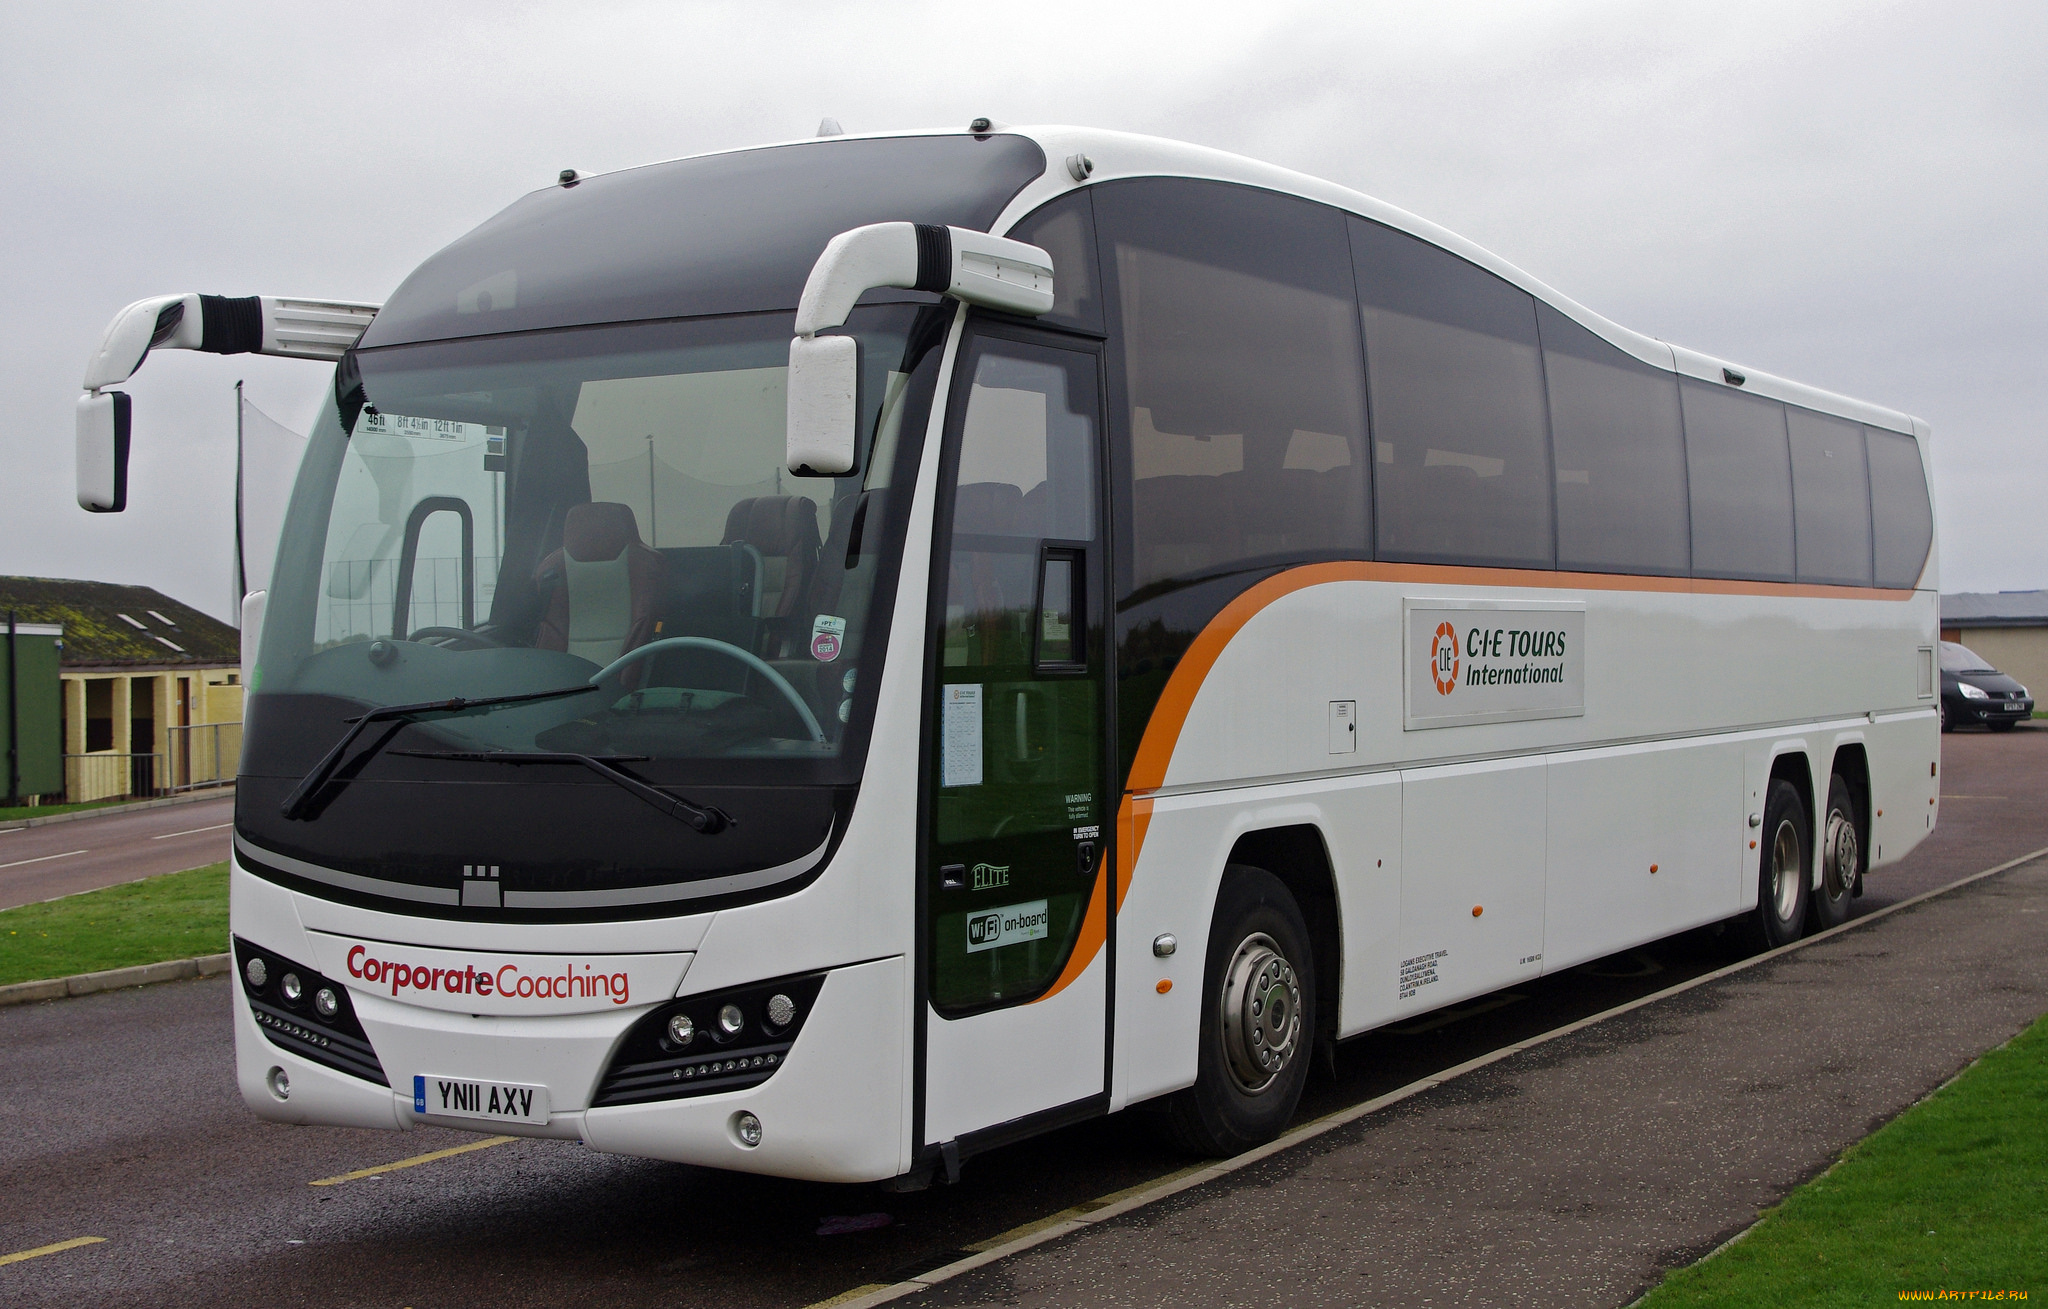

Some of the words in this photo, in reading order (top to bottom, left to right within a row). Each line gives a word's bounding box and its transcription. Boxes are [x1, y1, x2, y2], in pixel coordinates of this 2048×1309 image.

[397, 416, 409, 428] 8ft
[434, 420, 450, 433] 12ft
[1508, 630, 1566, 657] TOURS
[1439, 647, 1451, 671] CIE
[1466, 662, 1564, 686] International
[1065, 793, 1091, 803] WARNING
[973, 866, 1010, 889] ELITE
[1005, 909, 1046, 931] on-board
[347, 945, 494, 996] Corporate
[496, 964, 630, 1005] Coaching
[438, 1081, 480, 1112] YN11
[488, 1086, 533, 1117] AXV
